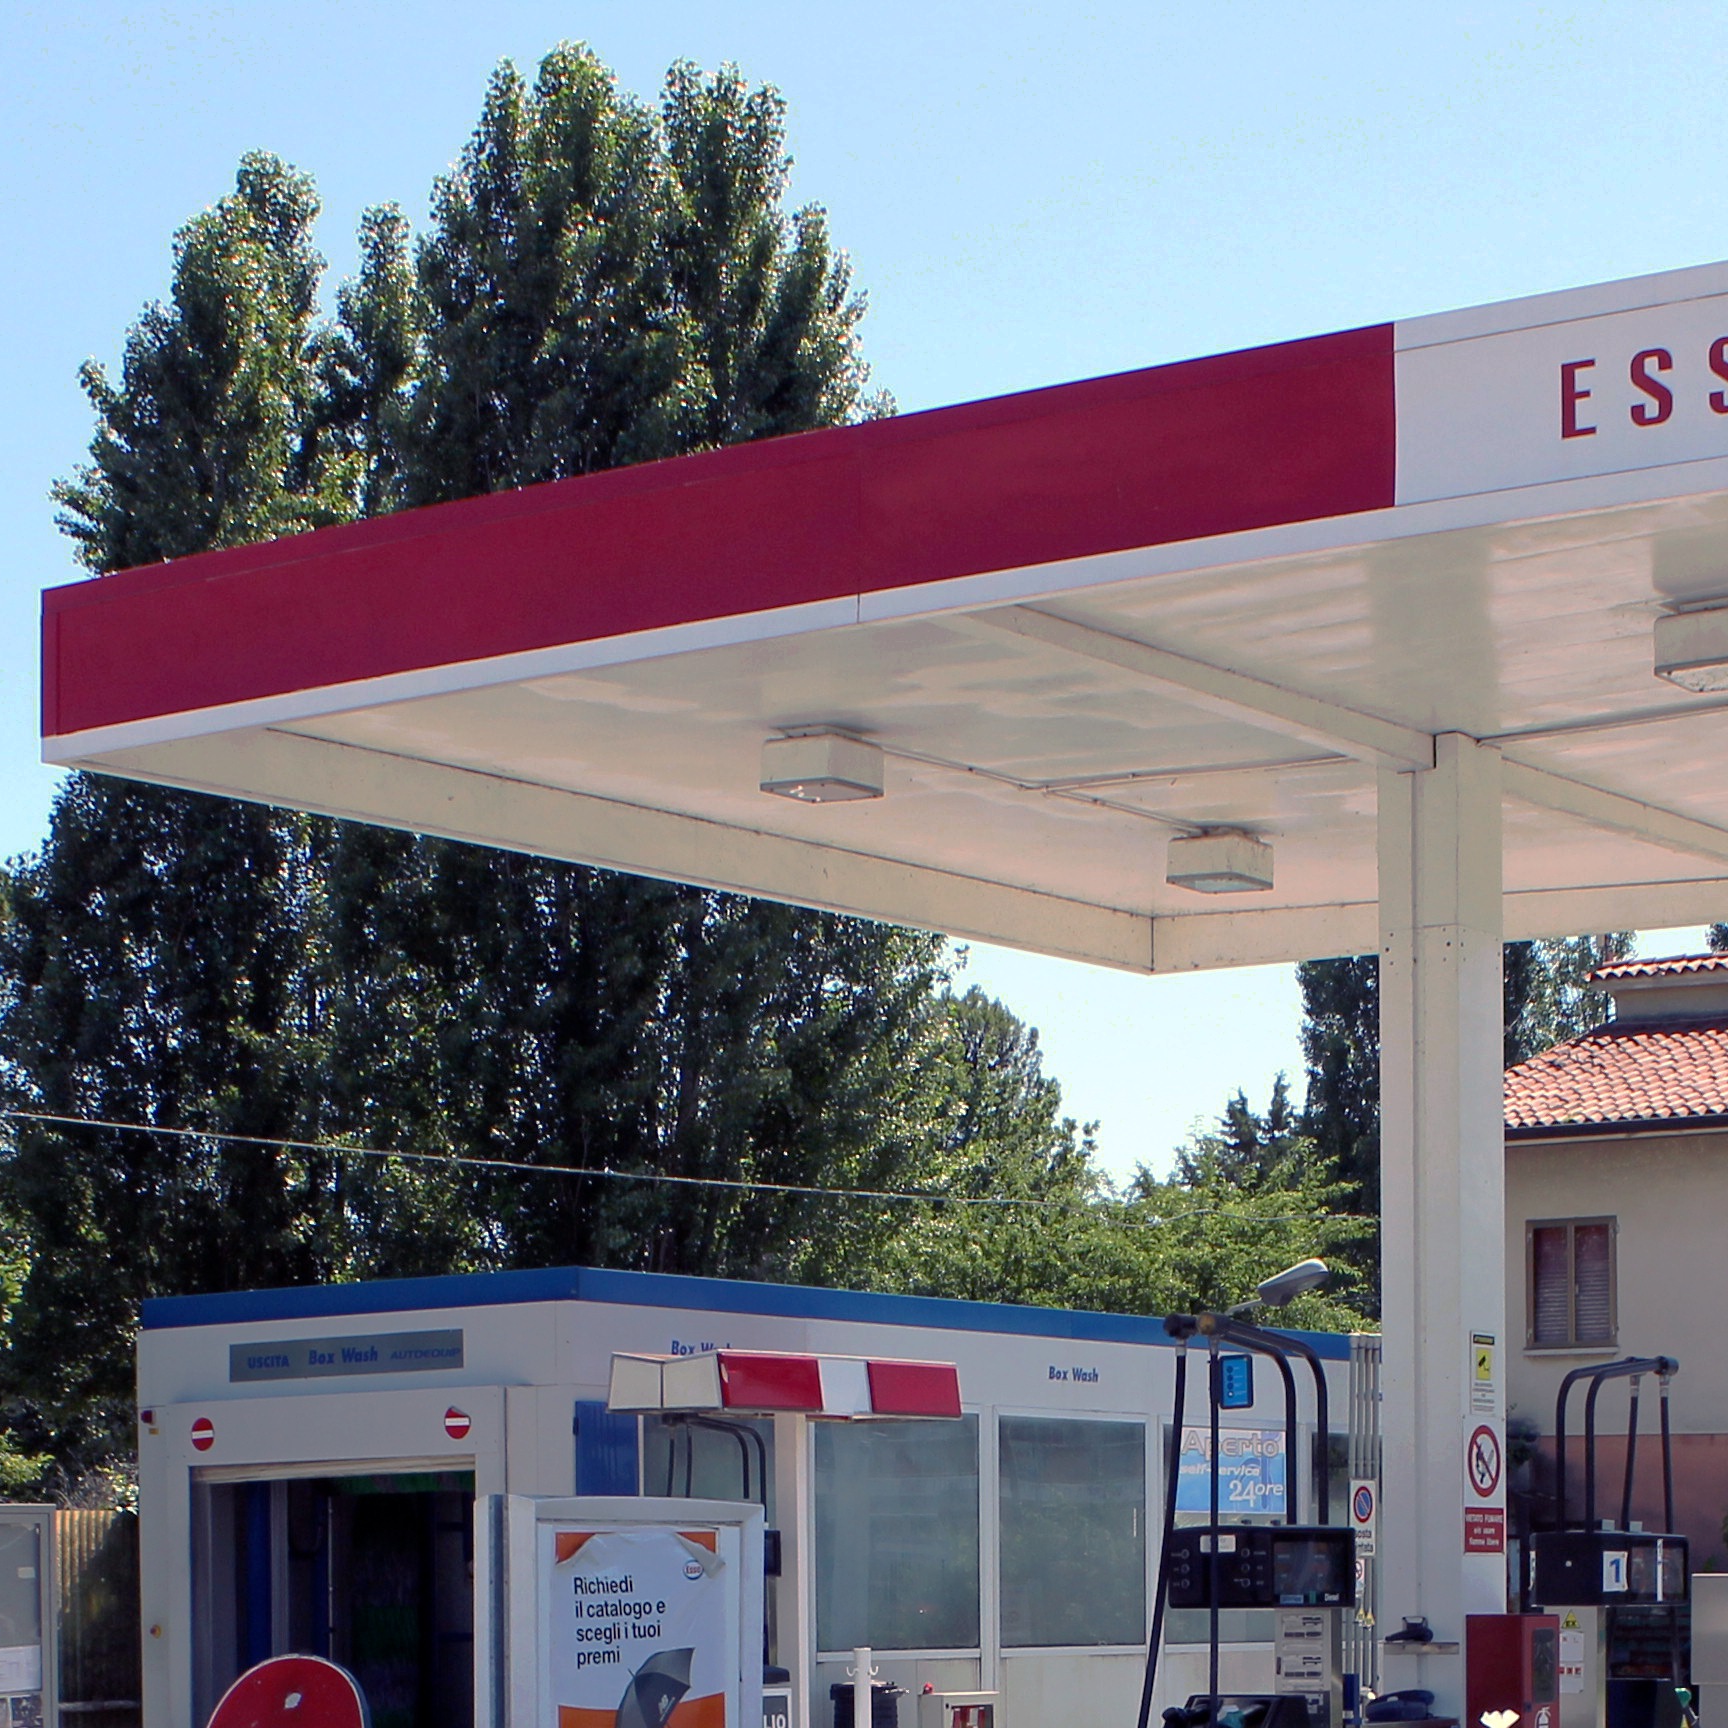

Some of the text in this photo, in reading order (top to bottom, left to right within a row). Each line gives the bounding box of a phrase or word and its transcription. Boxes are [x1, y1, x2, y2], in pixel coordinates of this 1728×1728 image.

[247, 1354, 290, 1370] USCITA
[308, 1349, 335, 1366] Box
[341, 1345, 379, 1364] Wash
[1048, 1365, 1099, 1383] Box Wash
[1229, 1479, 1284, 1508] 24 ore
[1608, 1557, 1621, 1584] 1
[573, 1575, 634, 1595] Richiedi
[575, 1599, 667, 1620] il catalogo e
[576, 1619, 661, 1645] scegli i tuoi
[577, 1645, 620, 1669] premi
